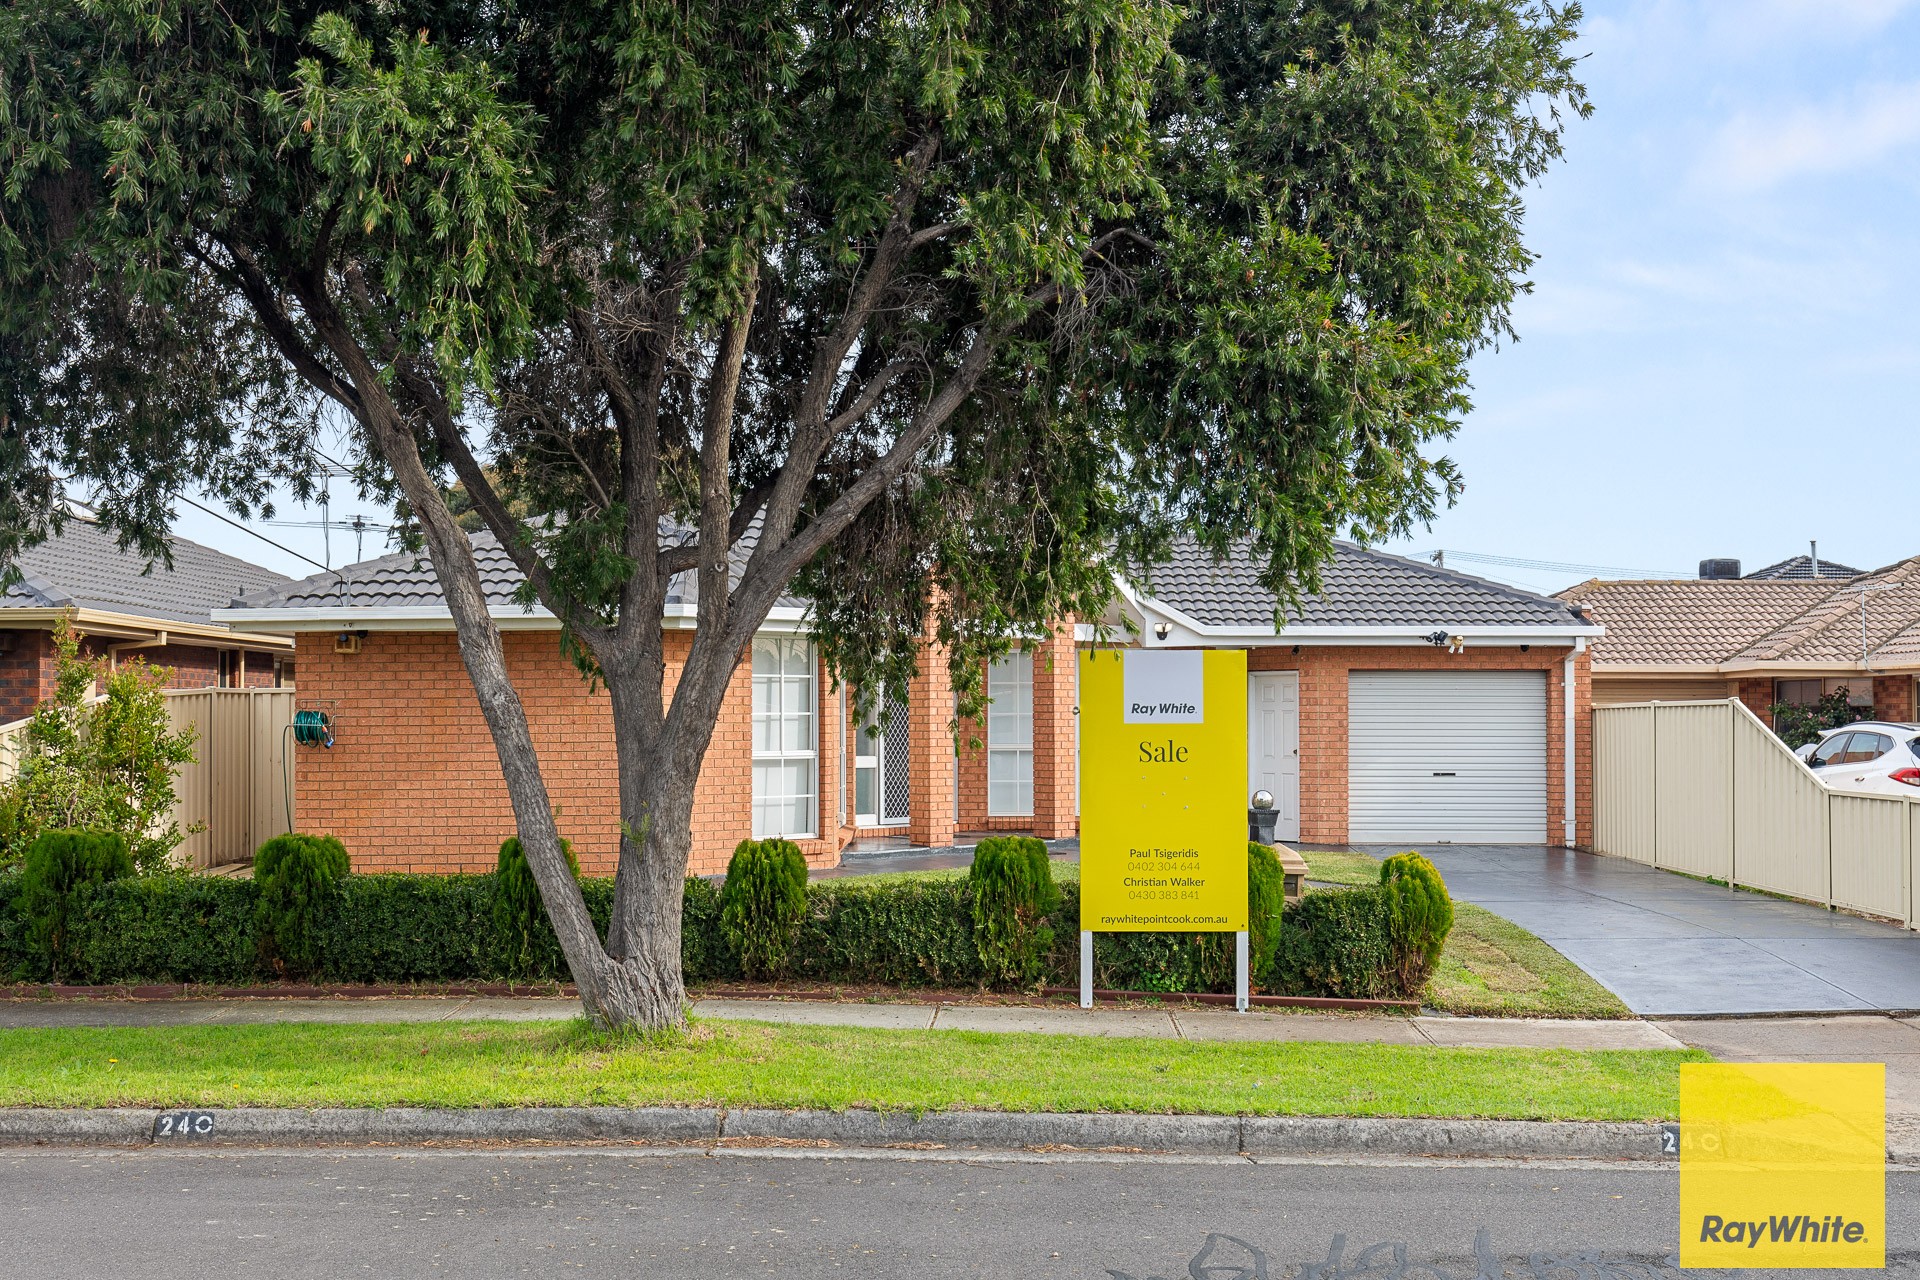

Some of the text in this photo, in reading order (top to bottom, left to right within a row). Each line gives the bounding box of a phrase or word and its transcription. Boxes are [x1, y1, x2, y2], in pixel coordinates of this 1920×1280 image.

[1131, 703, 1196, 716] Ray White
[1139, 739, 1188, 763] Sale
[1129, 848, 1199, 860] Paul Tsigeridis
[1127, 861, 1201, 872] 0402 304 644
[1123, 877, 1206, 887] Christian Walker
[1128, 890, 1200, 900] 0430 383 841
[1101, 914, 1228, 926] raywhitepointcook.com.au
